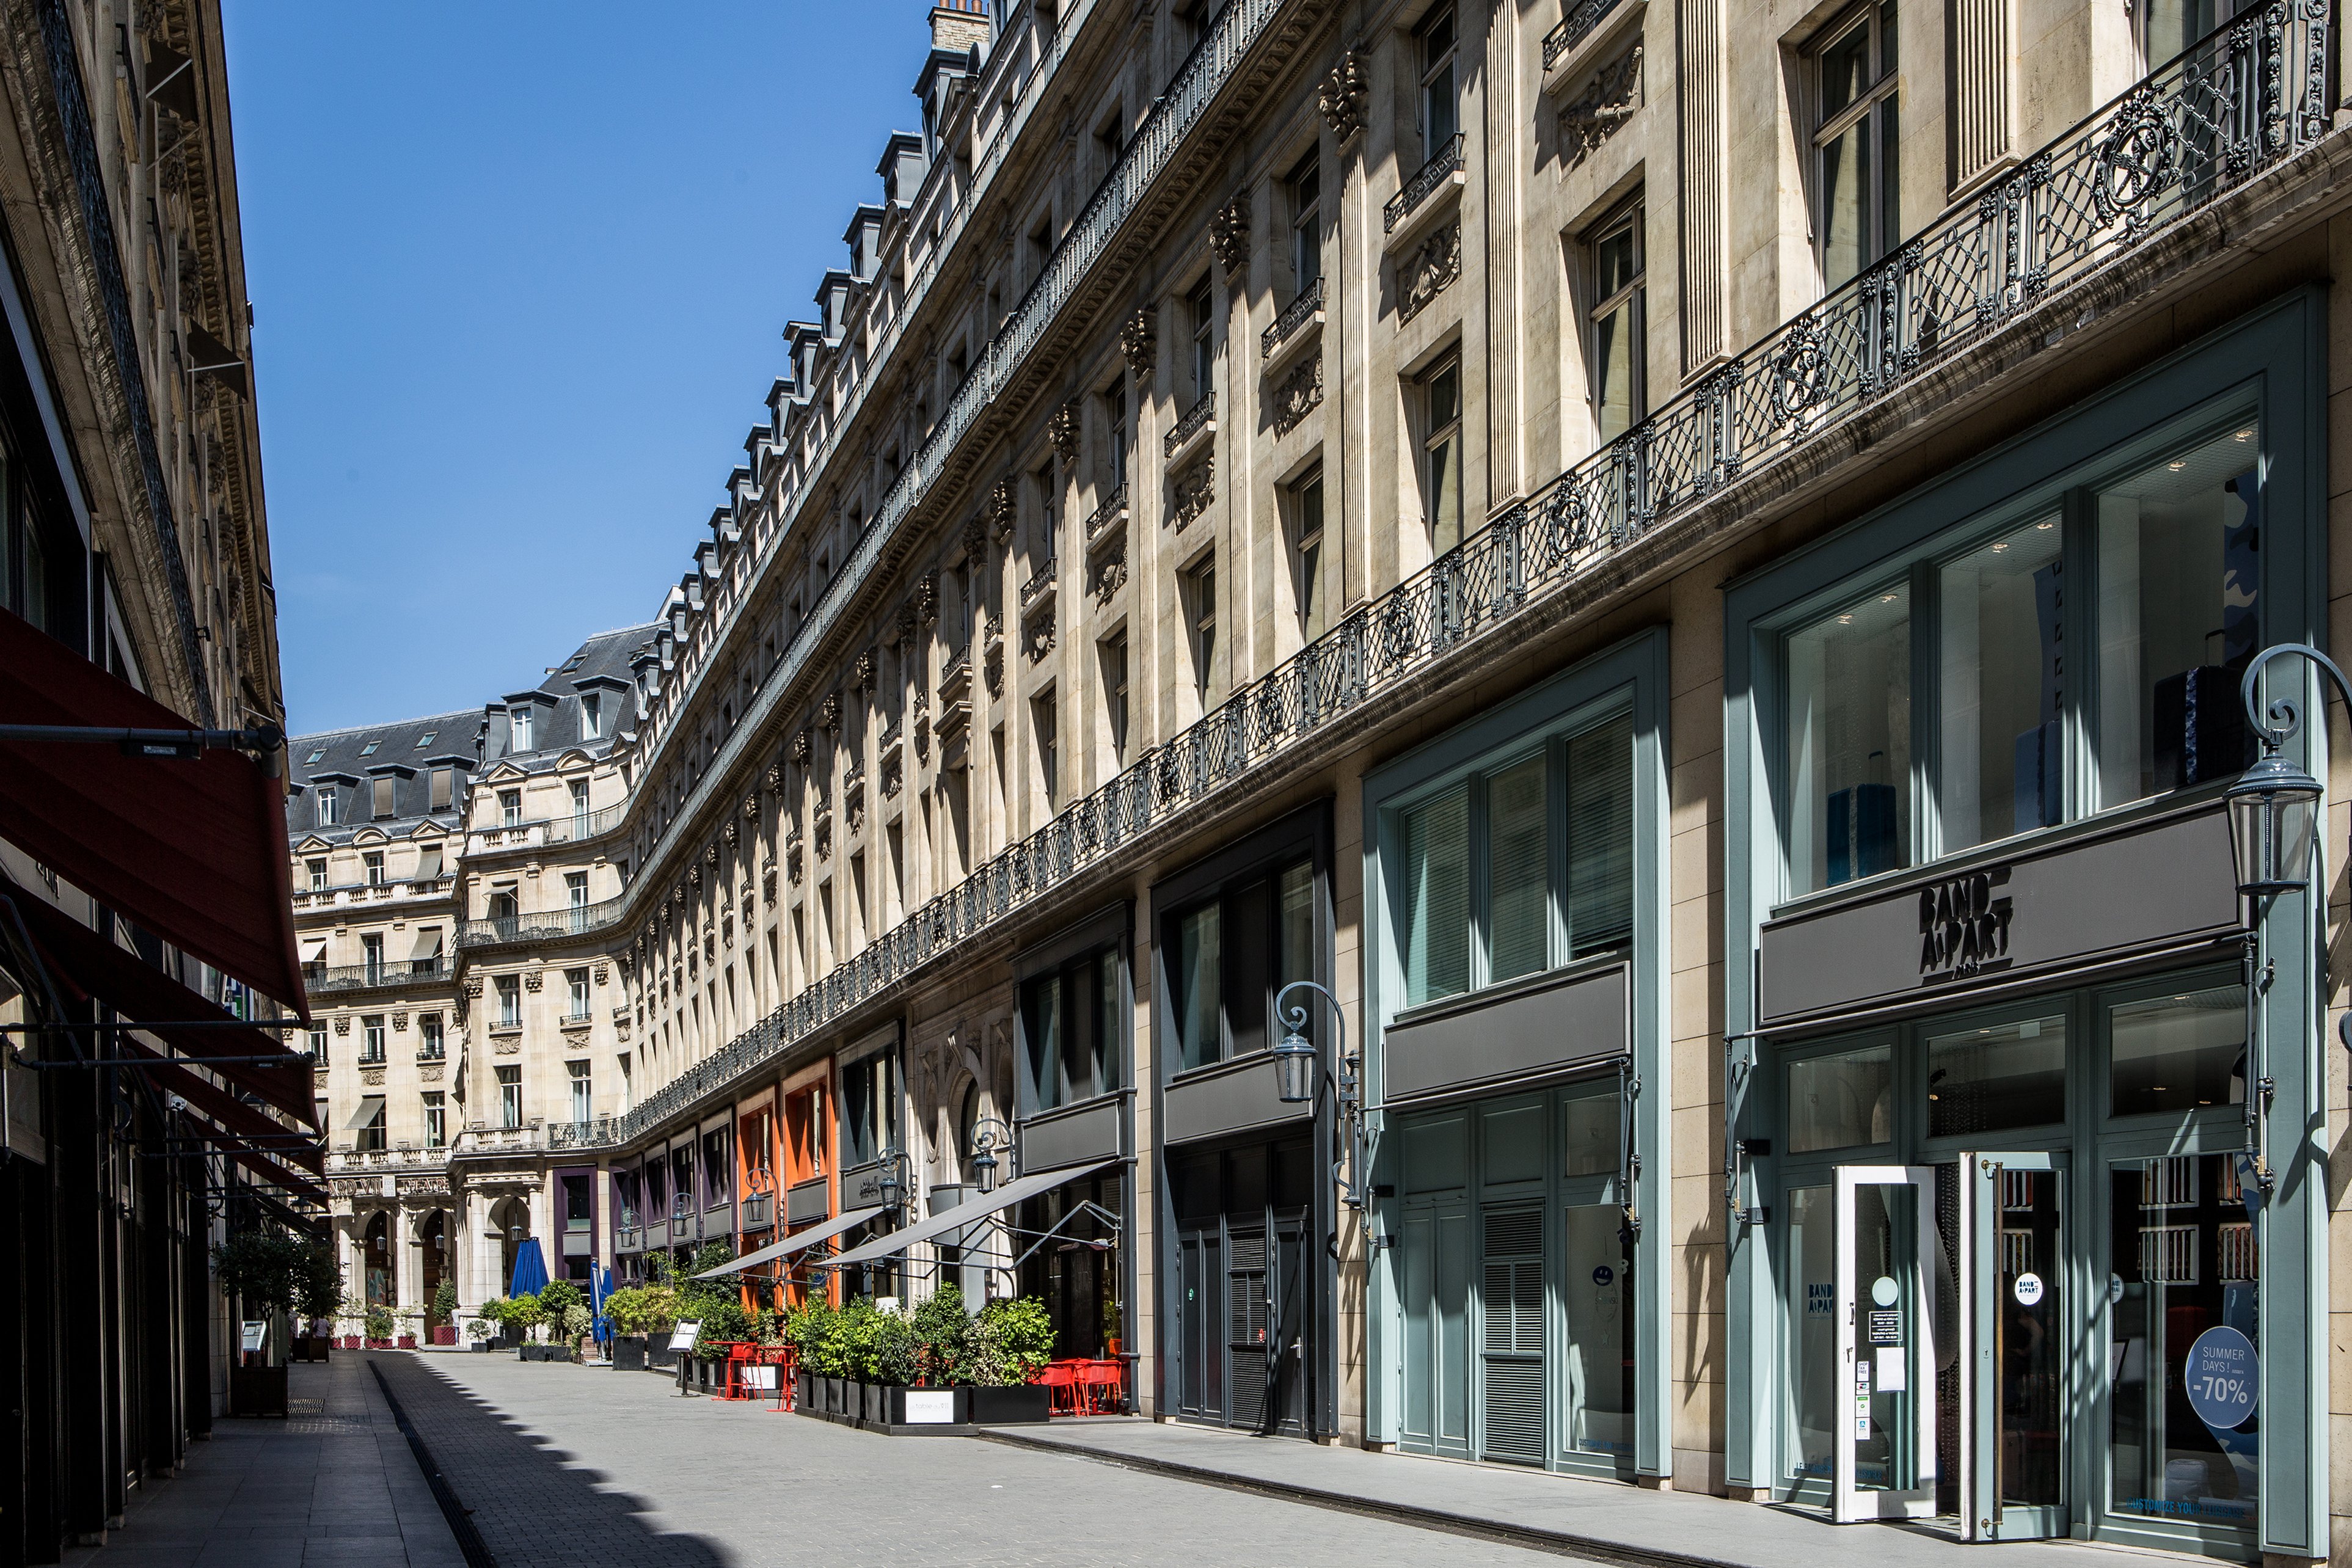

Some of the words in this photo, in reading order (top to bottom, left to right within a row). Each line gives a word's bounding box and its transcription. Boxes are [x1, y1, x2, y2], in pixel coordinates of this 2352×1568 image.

[2202, 1346, 2244, 1361] SUMMER
[2193, 1376, 2248, 1404] -70%
[2126, 1497, 2175, 1513] CUSTOMIZE
[2177, 1502, 2201, 1515] YOUR
